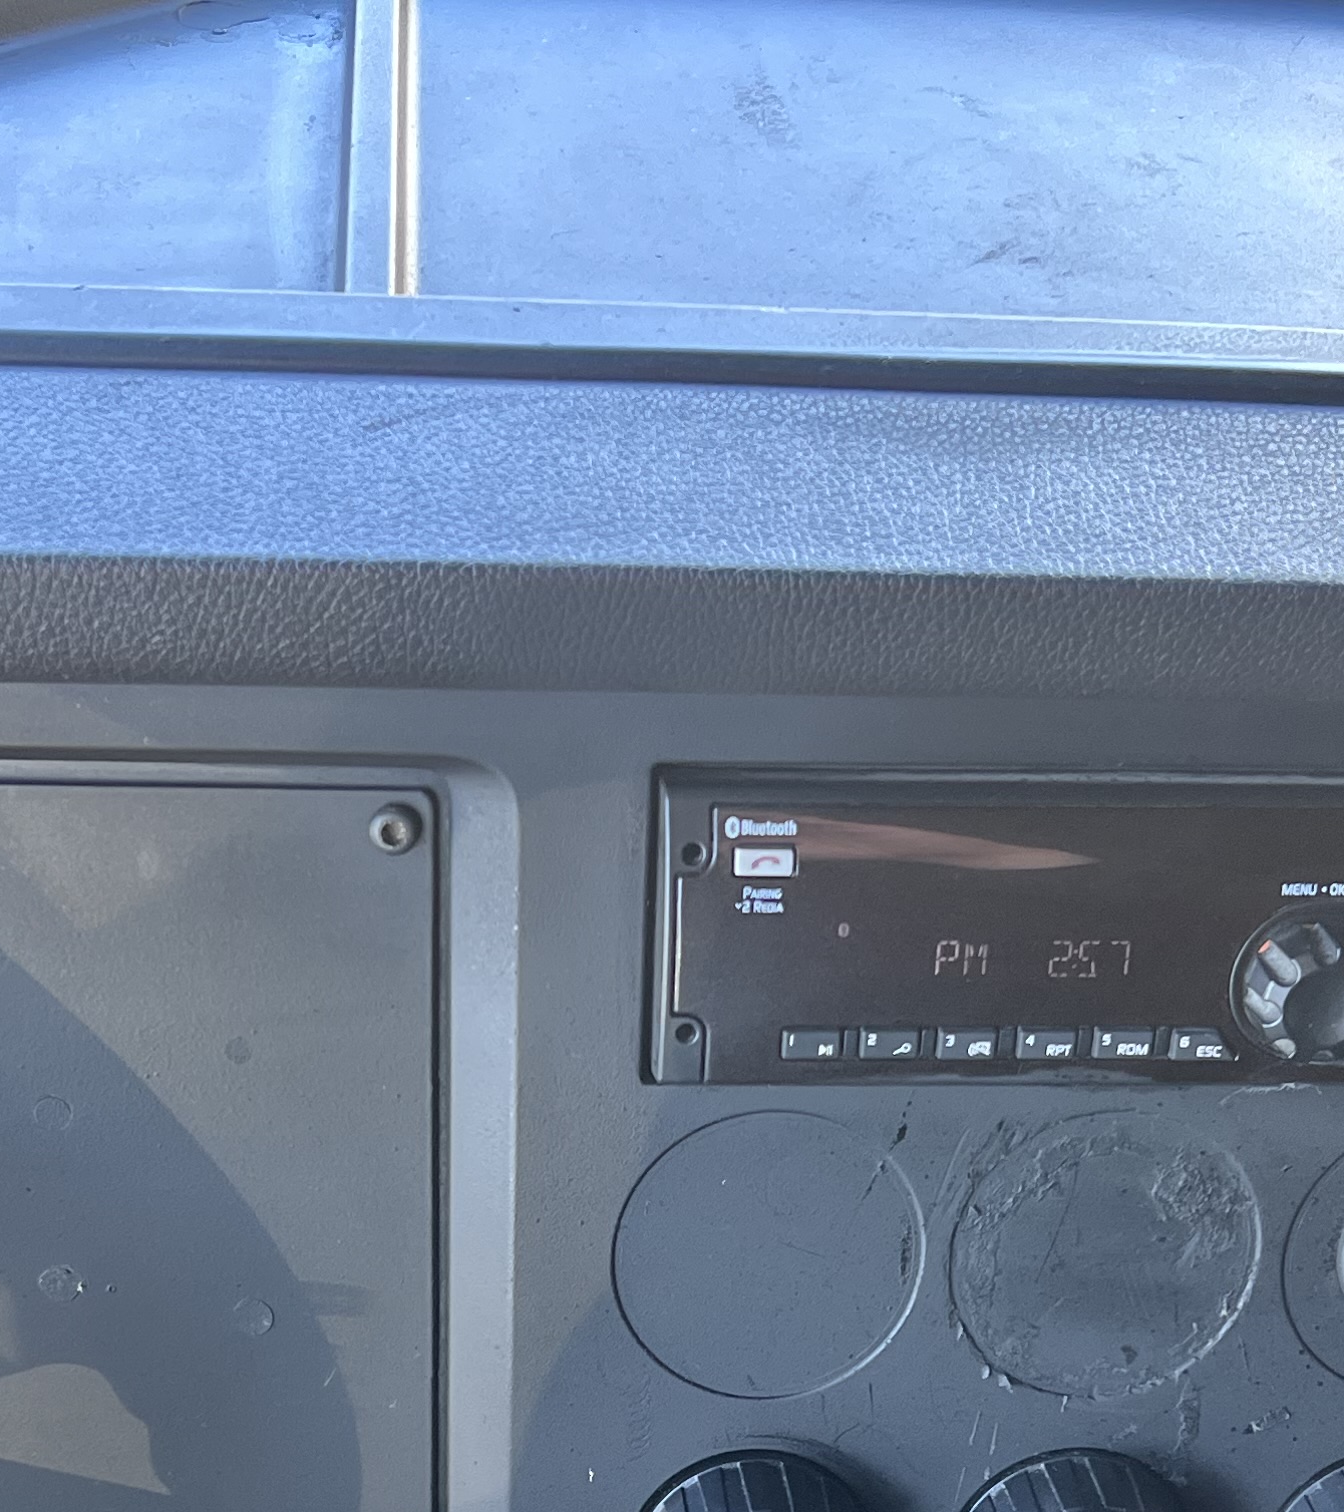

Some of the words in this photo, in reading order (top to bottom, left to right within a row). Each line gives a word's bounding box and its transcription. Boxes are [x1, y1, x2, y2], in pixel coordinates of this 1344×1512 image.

[740, 819, 798, 836] Bluetooth
[1281, 882, 1318, 896] MENU
[934, 939, 988, 976] PM
[1048, 939, 1131, 978] 2:57
[867, 1033, 878, 1046] 2
[945, 1034, 955, 1047] 3
[1025, 1034, 1035, 1047] 4
[1101, 1033, 1112, 1046] 5
[1179, 1036, 1190, 1048] 6
[1045, 1044, 1072, 1057] RPT
[1116, 1043, 1149, 1056] RDM
[1195, 1045, 1223, 1058] ESC
